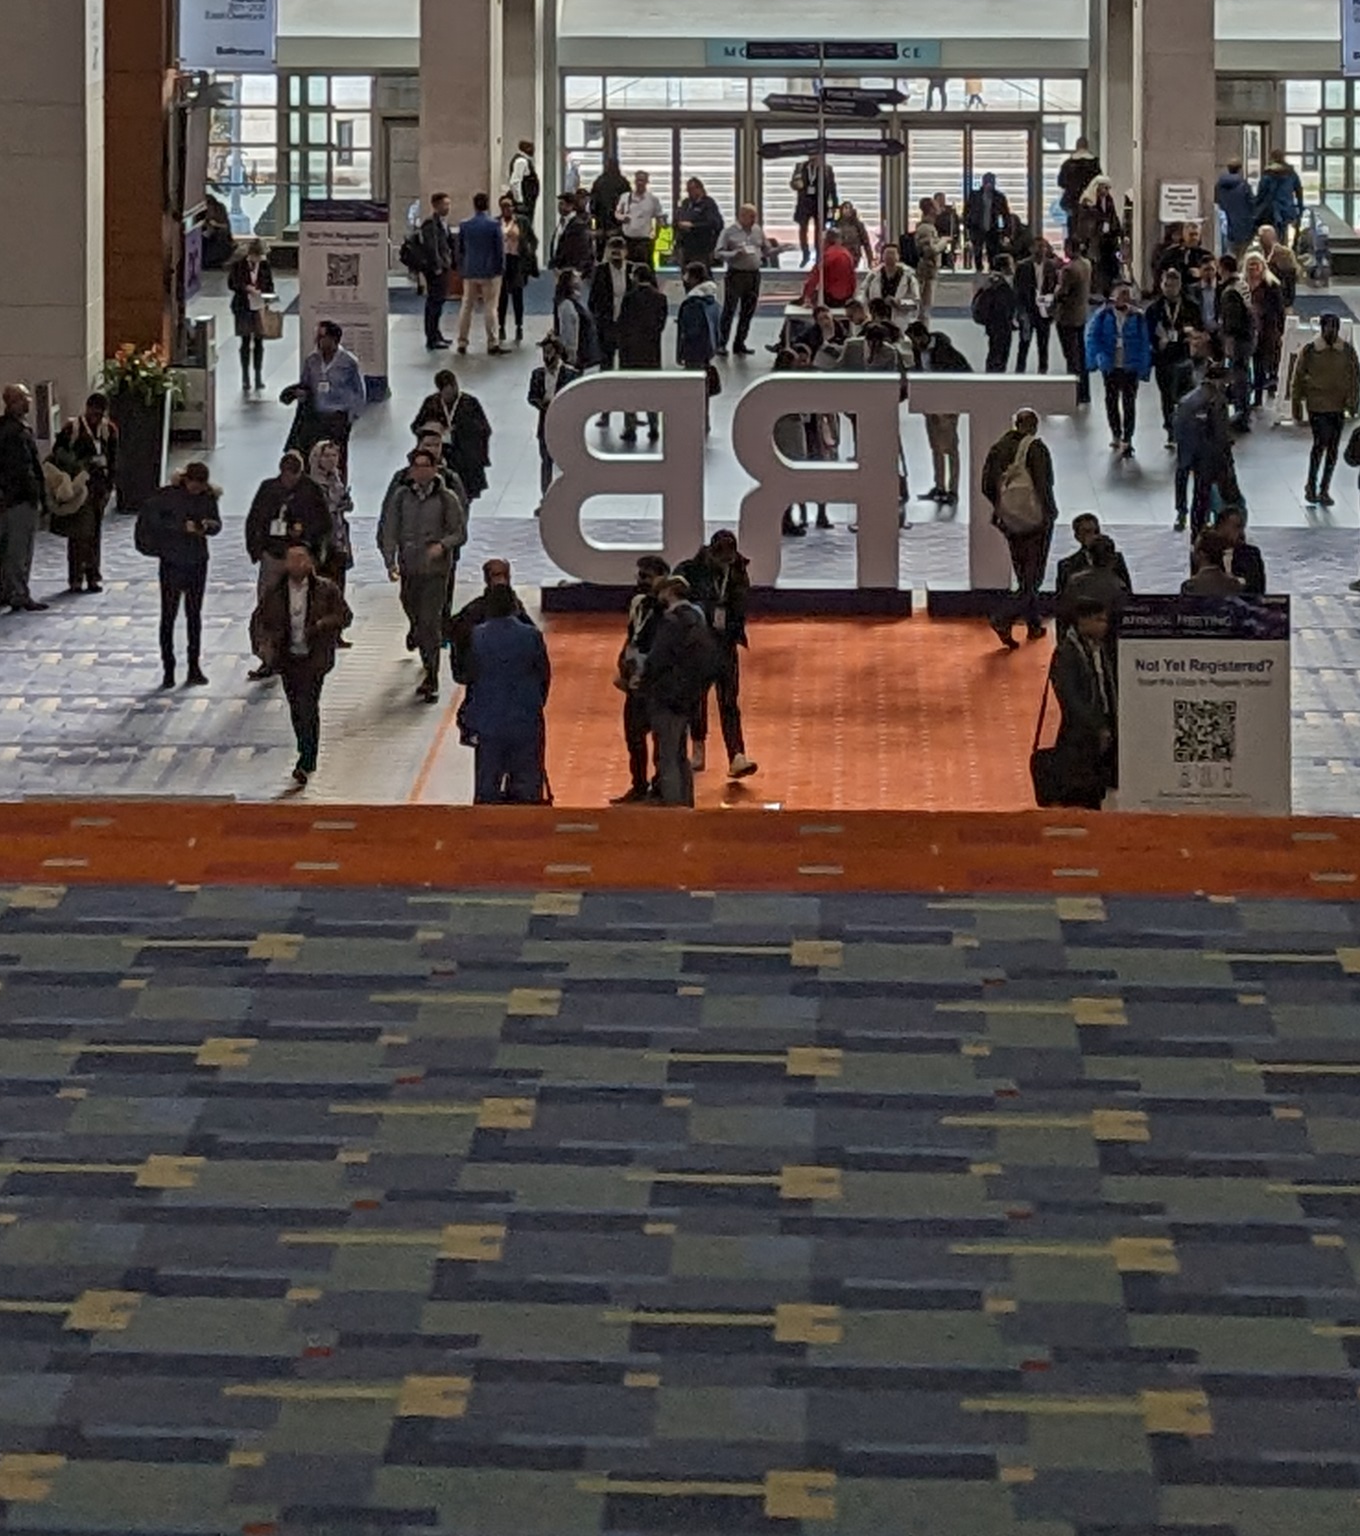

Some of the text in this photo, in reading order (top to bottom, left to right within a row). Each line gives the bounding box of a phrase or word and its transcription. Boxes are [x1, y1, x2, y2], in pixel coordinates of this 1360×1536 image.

[1135, 658, 1274, 676] Not Yet Registered?
